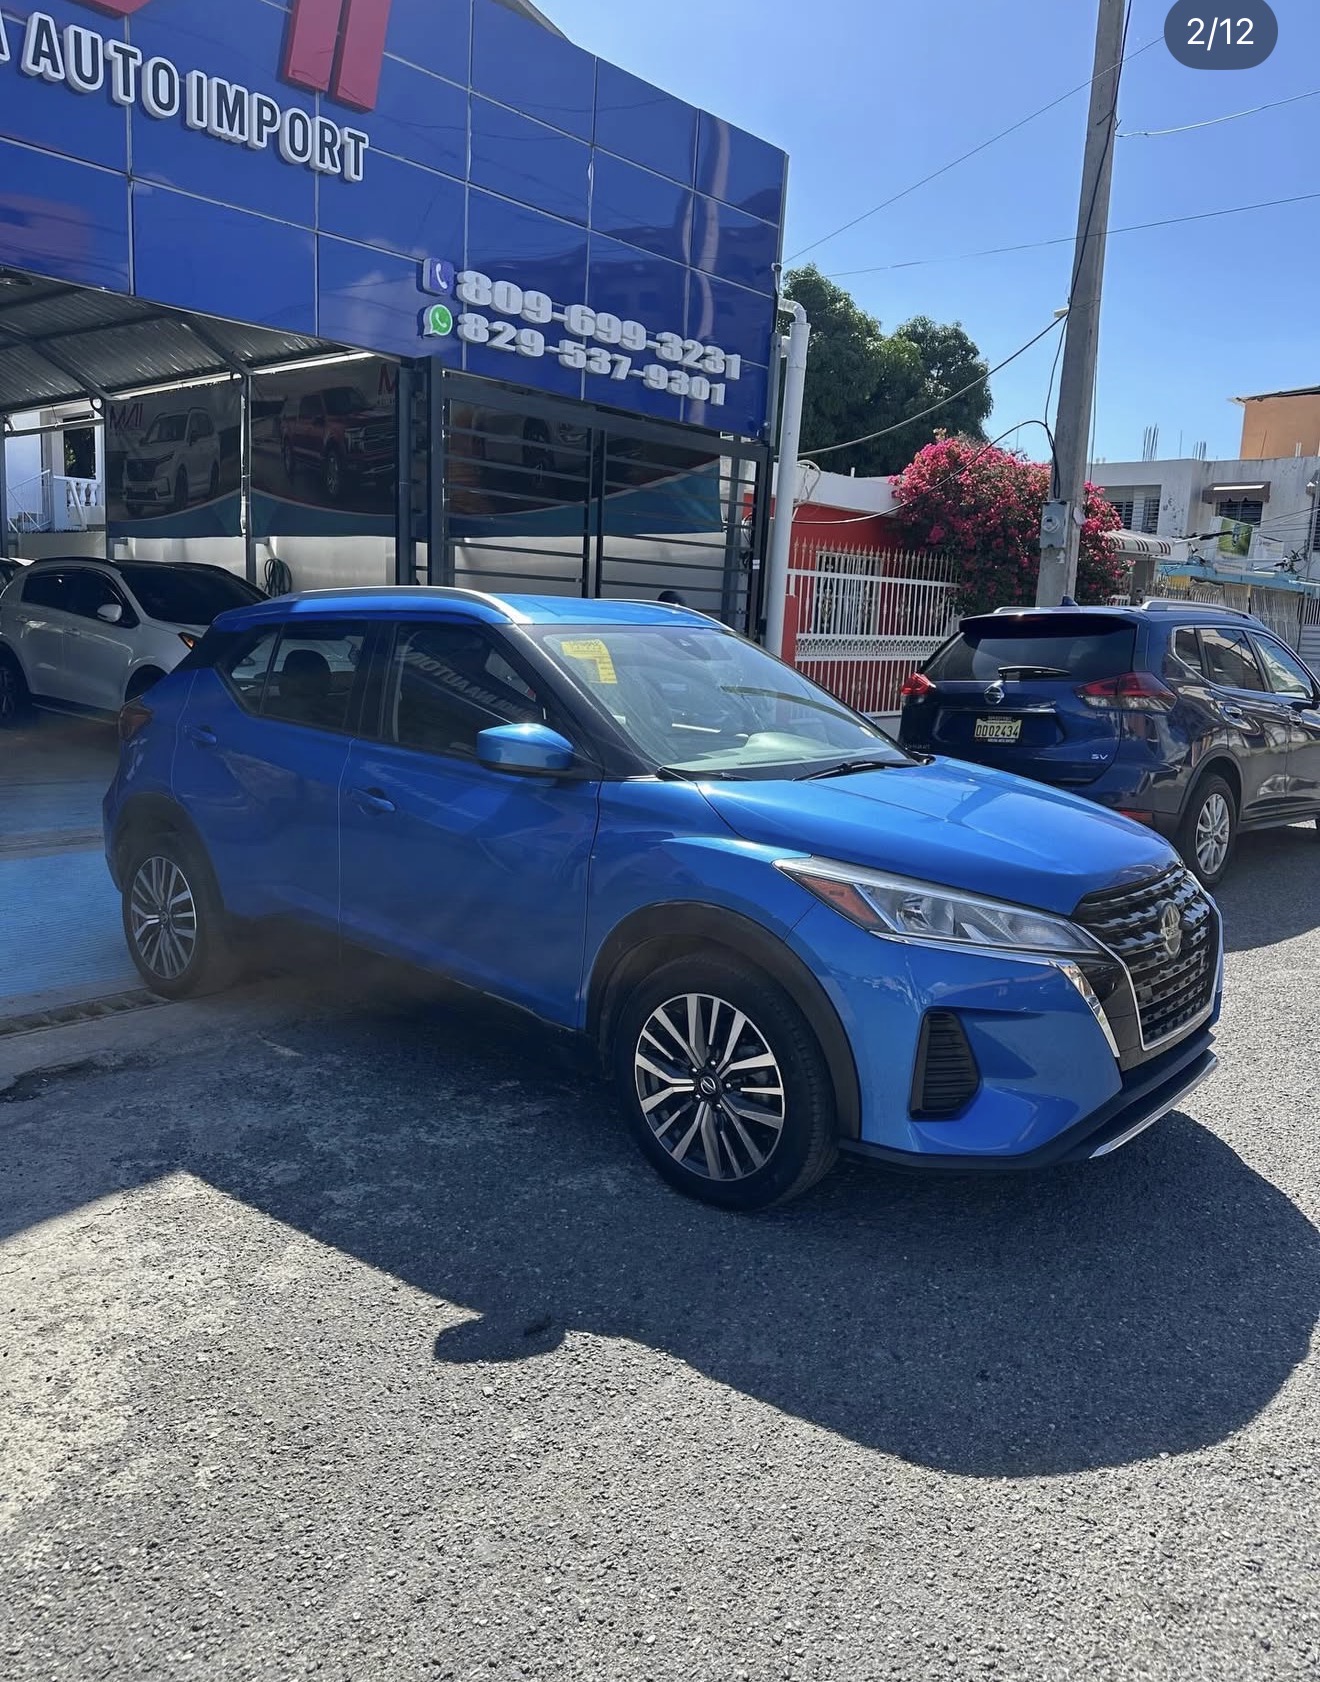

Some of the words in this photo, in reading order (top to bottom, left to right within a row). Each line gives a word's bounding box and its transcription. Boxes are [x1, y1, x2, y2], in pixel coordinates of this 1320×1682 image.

[21, 12, 179, 119] AUTO
[186, 70, 369, 182] IMPORT
[457, 270, 741, 380] 809-699-3231
[458, 312, 726, 406] 829-537-9301
